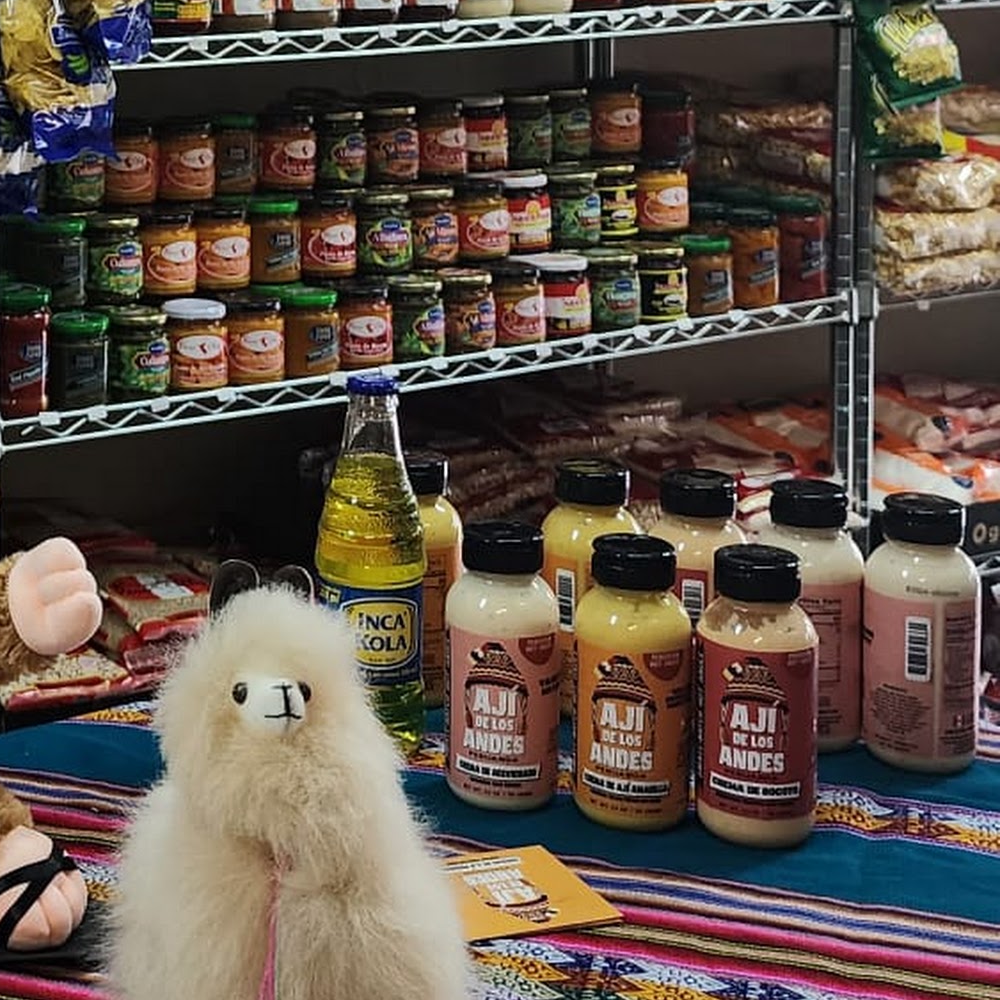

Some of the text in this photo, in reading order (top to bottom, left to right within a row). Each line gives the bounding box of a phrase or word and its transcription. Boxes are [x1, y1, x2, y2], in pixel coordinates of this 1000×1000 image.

[357, 611, 406, 631] INCA
[474, 718, 514, 731] DE LOS
[462, 731, 525, 755] ANDES
[601, 732, 642, 747] DE LOS
[733, 735, 773, 749] DE LOS
[589, 747, 653, 770] ANDES
[718, 747, 785, 774] ANDES
